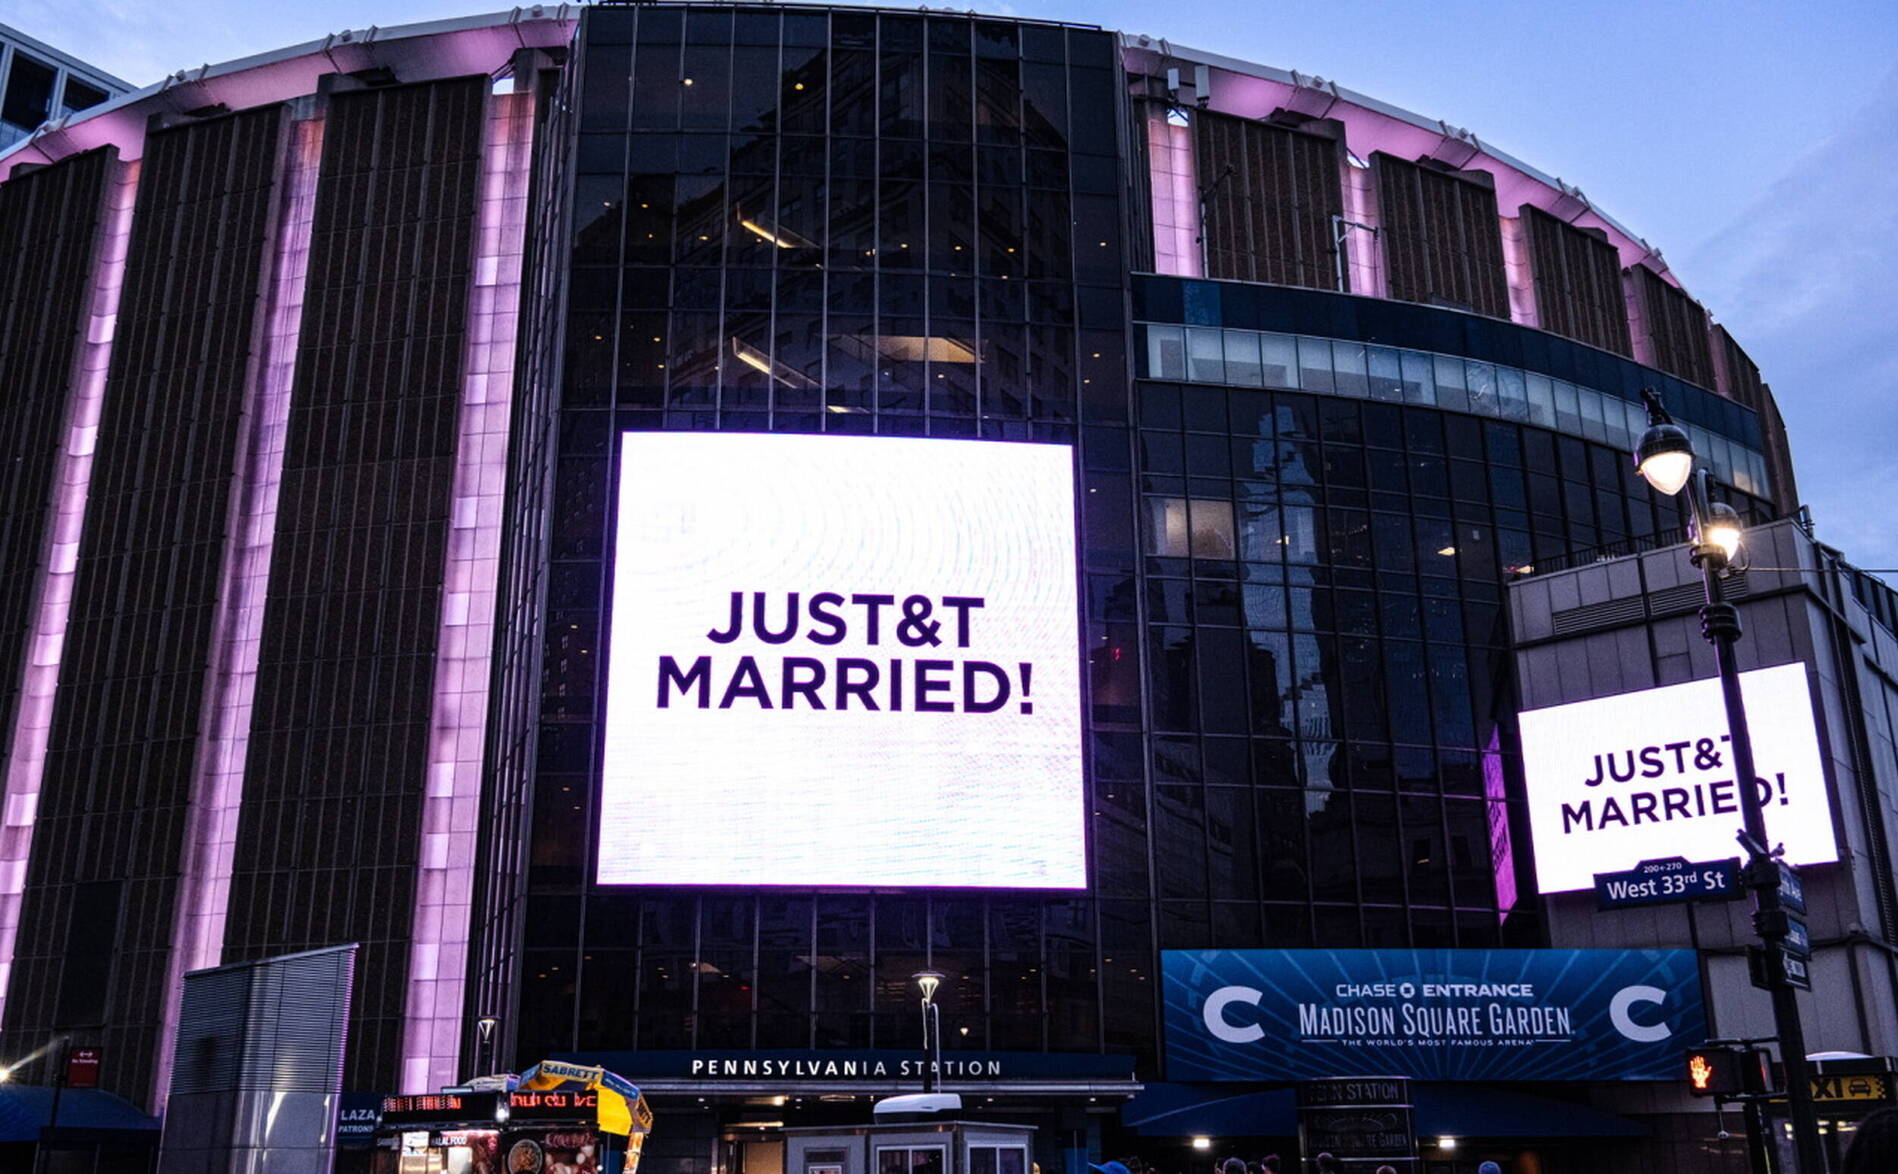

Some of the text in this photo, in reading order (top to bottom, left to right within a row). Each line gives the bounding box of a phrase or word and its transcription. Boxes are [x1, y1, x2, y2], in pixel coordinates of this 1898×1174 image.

[706, 591, 985, 648] JUST&T
[657, 655, 1033, 715] MARRIED!
[1585, 735, 1731, 787] JUST&
[1607, 871, 1726, 900] West 33rd St
[1336, 984, 1534, 997] CHASE ENTRANCE
[1203, 985, 1266, 1044] C
[1298, 1003, 1571, 1038] MADISON SQUARE GARDEN
[1609, 985, 1672, 1043] C
[1451, 1039, 1494, 1047] FAMOUS
[543, 1064, 599, 1080] SABRETT
[692, 1060, 1000, 1076] PENNSYLVANIA STATION
[1346, 1082, 1399, 1100] STATION
[1809, 1077, 1844, 1099] XI
[340, 1109, 376, 1121] LAZA
